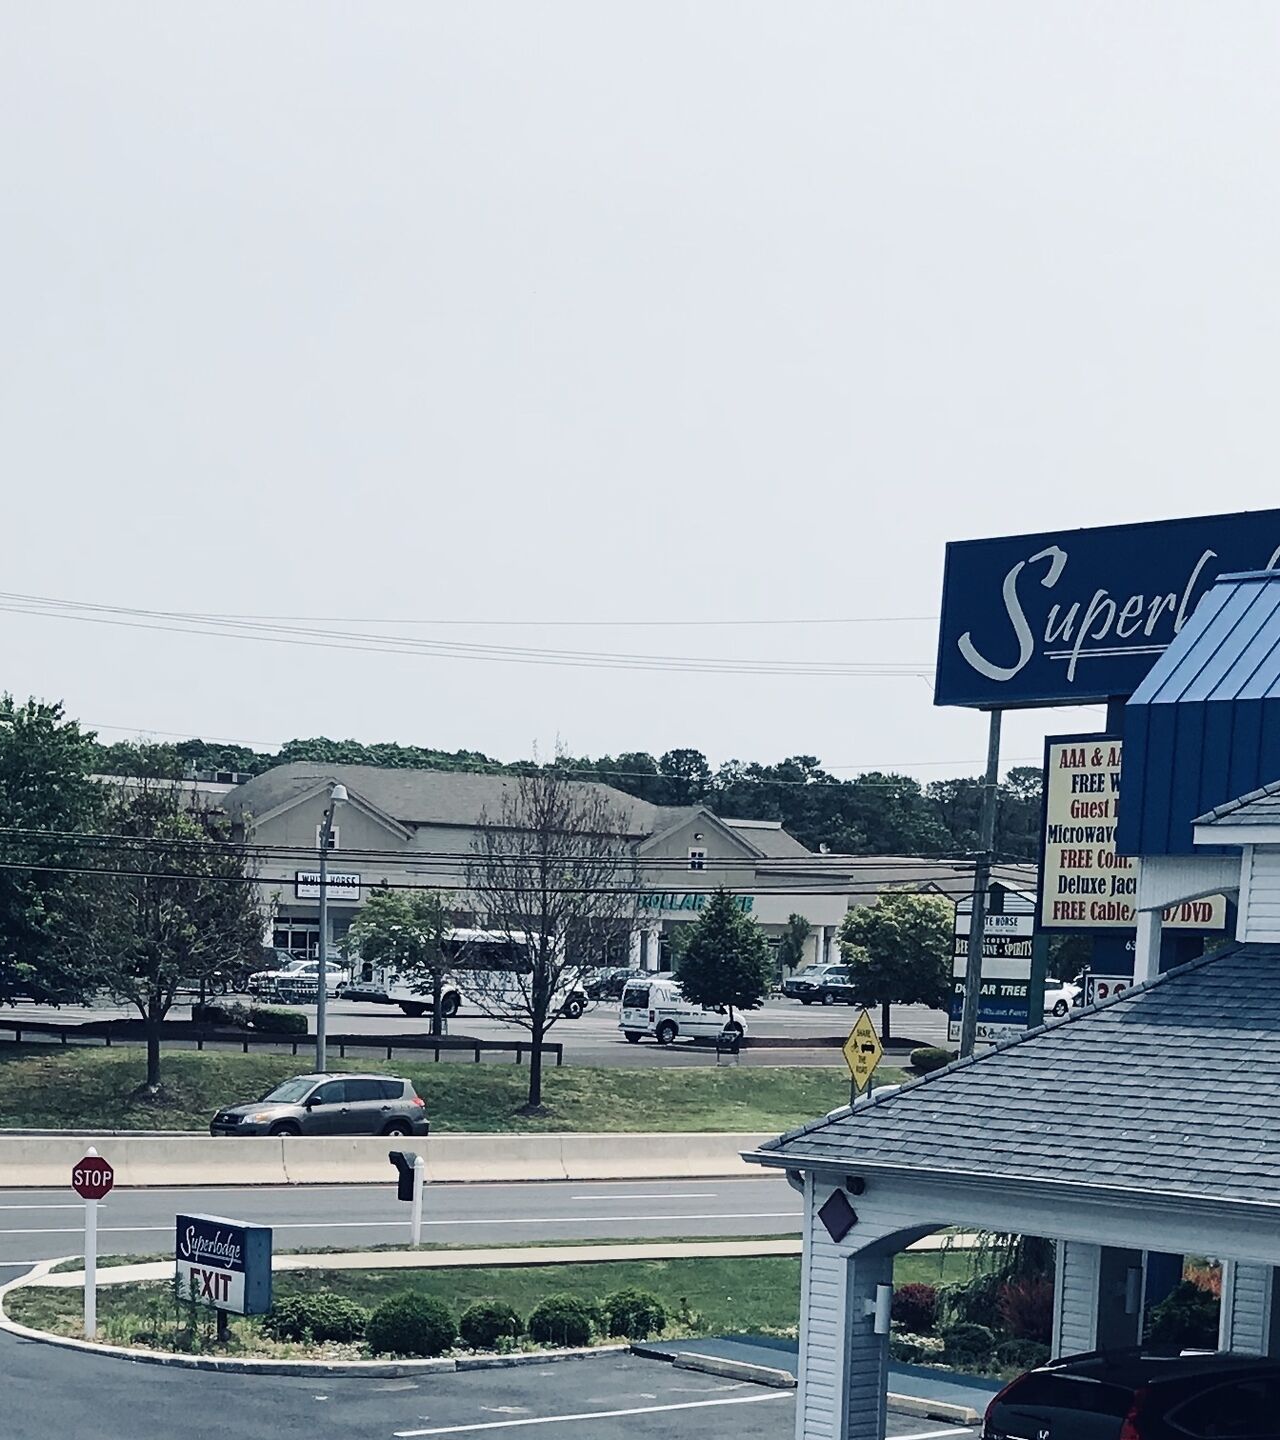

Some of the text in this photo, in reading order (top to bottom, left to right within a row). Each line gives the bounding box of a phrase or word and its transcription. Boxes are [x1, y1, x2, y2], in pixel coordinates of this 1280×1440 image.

[1060, 748, 1087, 769] AAA
[1091, 747, 1104, 767] &
[1071, 772, 1106, 794] FREE
[1070, 798, 1110, 819] Guest
[1060, 849, 1093, 869] FREE
[1058, 874, 1107, 895] Deluxe
[1053, 900, 1086, 921] FREE
[955, 938, 969, 954] BEE
[1004, 940, 1032, 956] SPIRITS
[1000, 985, 1028, 997] TREE
[74, 1169, 112, 1187] STOP
[180, 1225, 241, 1268] Superlodge
[190, 1267, 233, 1302] EXIT
